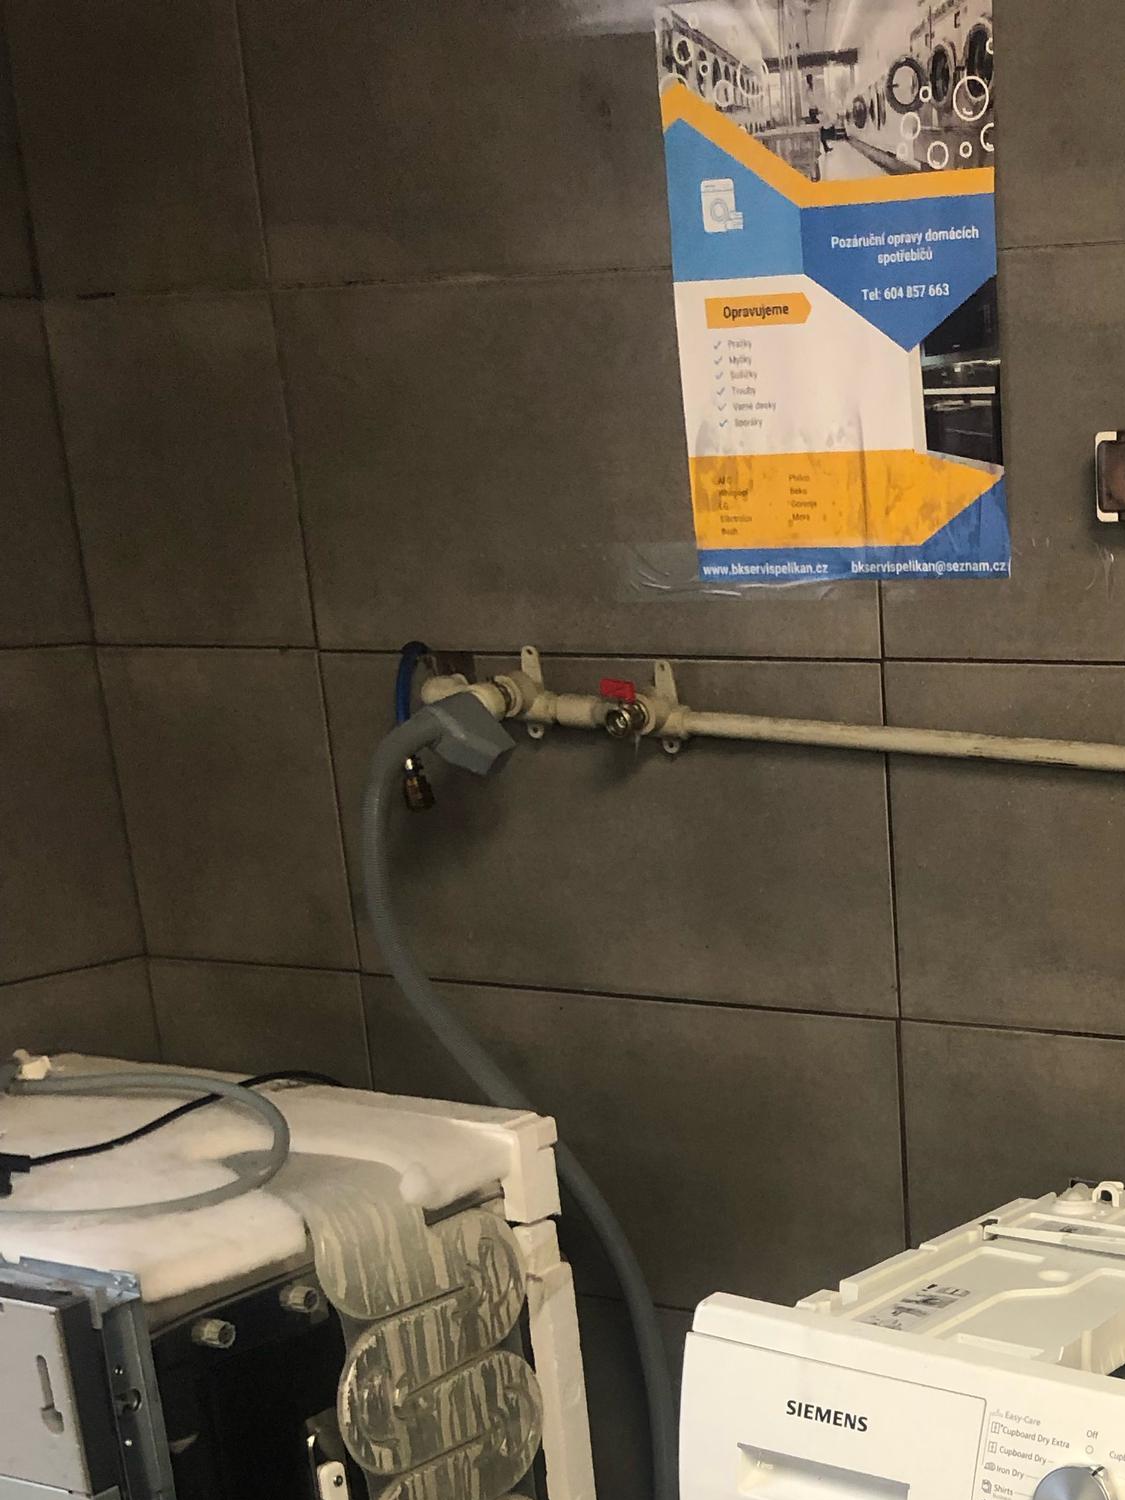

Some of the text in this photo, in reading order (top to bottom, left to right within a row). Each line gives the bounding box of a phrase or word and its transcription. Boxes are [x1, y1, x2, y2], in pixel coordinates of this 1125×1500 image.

[831, 225, 979, 248] Pozáruční opravy domácích
[877, 246, 933, 266] spotřebičů
[883, 286, 904, 299] 604
[928, 283, 950, 297] 663
[723, 303, 789, 320] Opravujeme
[702, 561, 829, 577] www.bkservispelikan.cz
[851, 559, 1007, 576] bkservispelikan@seznam.cz
[785, 1399, 868, 1432] SIEMENS
[1001, 1425, 1070, 1449] Cupboard Dry Extra
[1086, 1429, 1099, 1440] Off
[999, 1445, 1047, 1466] Cupboard Dry
[996, 1465, 1024, 1480] Iron Dry
